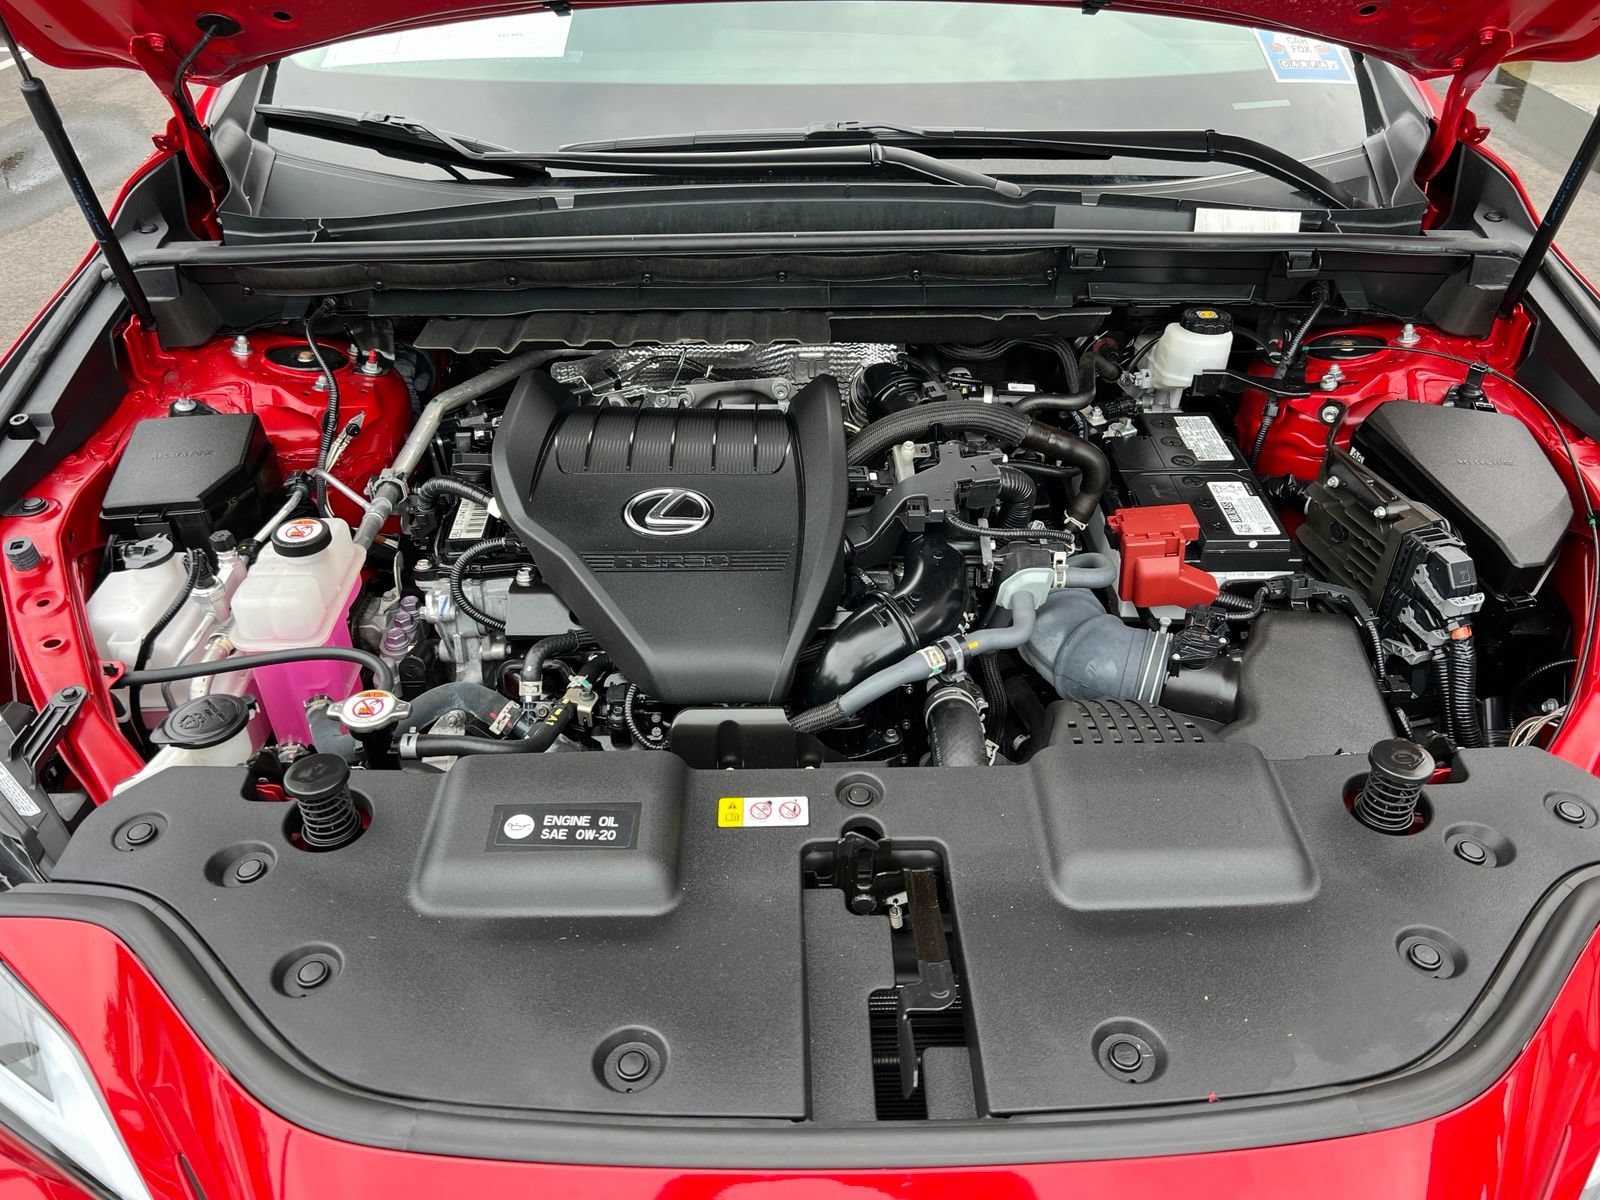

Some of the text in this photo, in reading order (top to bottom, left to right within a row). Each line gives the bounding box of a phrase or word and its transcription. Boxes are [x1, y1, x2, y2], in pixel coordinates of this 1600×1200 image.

[1290, 44, 1312, 53] FOX
[616, 554, 729, 568] TURBO
[543, 815, 619, 827] ENGINE OIL
[540, 828, 617, 840] SAE 0W-20
